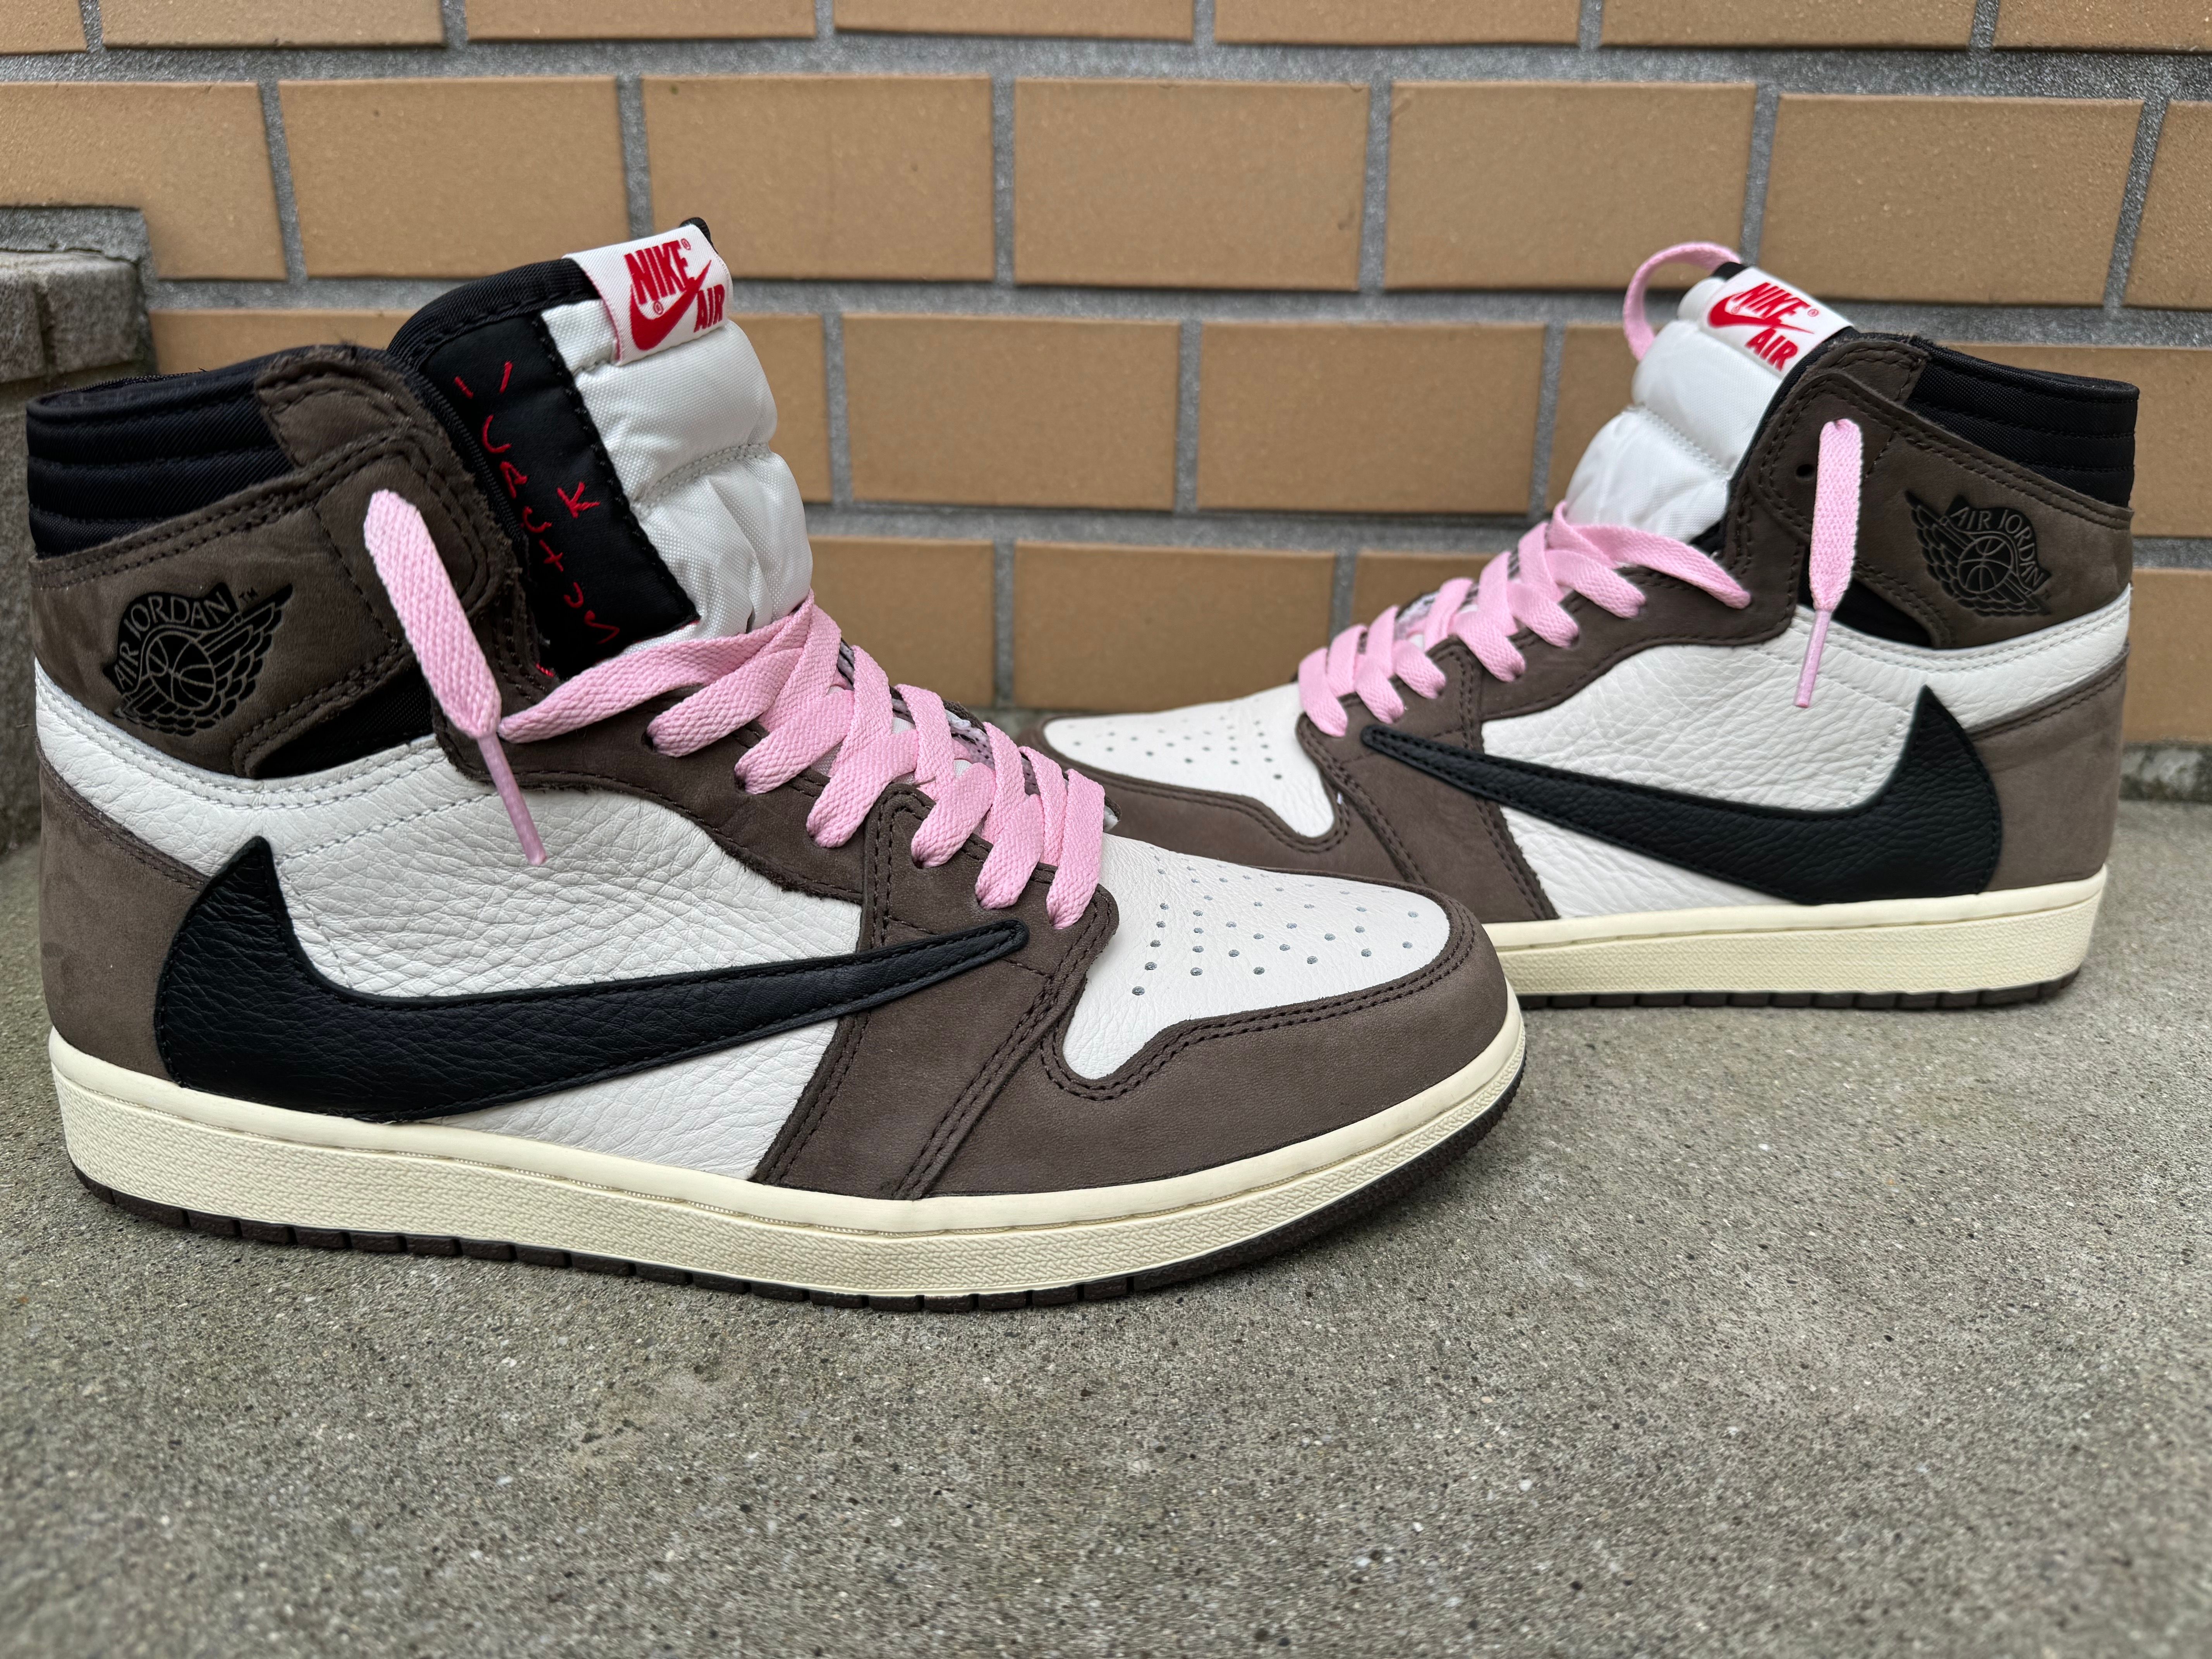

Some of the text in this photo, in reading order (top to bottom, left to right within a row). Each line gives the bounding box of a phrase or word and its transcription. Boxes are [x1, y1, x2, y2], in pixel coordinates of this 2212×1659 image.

[624, 240, 695, 305] NIKE
[693, 284, 725, 333] AIR
[1731, 282, 1812, 325] NIKE
[1745, 328, 1799, 372] AIR
[1949, 506, 2045, 587] AIR JORDAN
[124, 591, 231, 641] JORDAN
[114, 641, 139, 690] AIR
